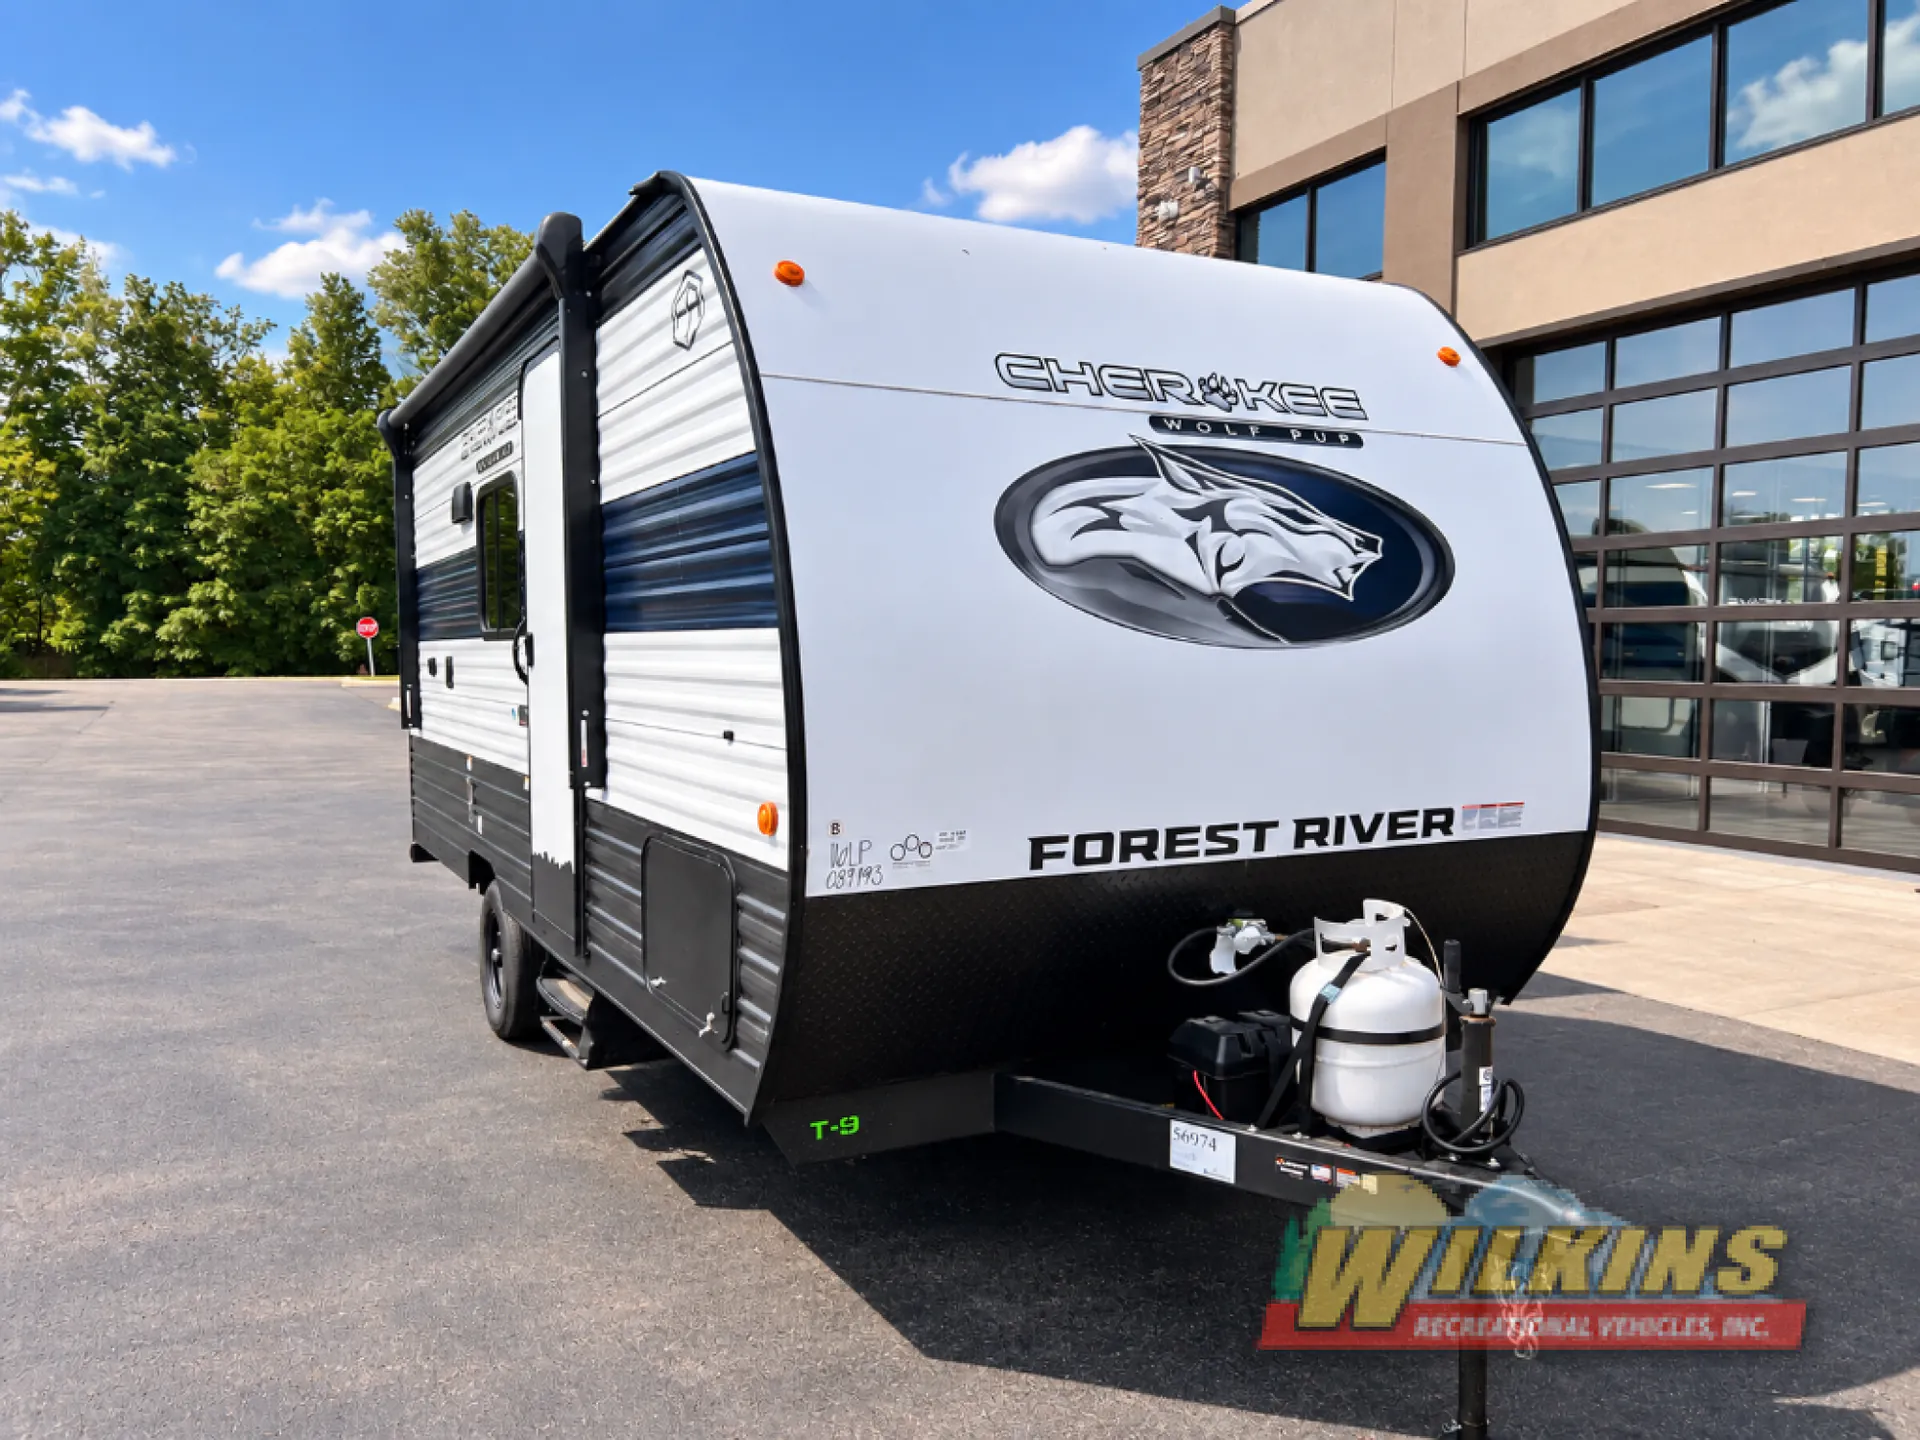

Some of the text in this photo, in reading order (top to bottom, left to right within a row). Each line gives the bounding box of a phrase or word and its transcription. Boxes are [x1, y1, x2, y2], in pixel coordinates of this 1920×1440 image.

[1163, 417, 1351, 445] WOLF PUP
[831, 822, 841, 835] B
[1028, 820, 1279, 870] FOREST
[1293, 807, 1454, 850] RIVER
[809, 1115, 860, 1140] T-9
